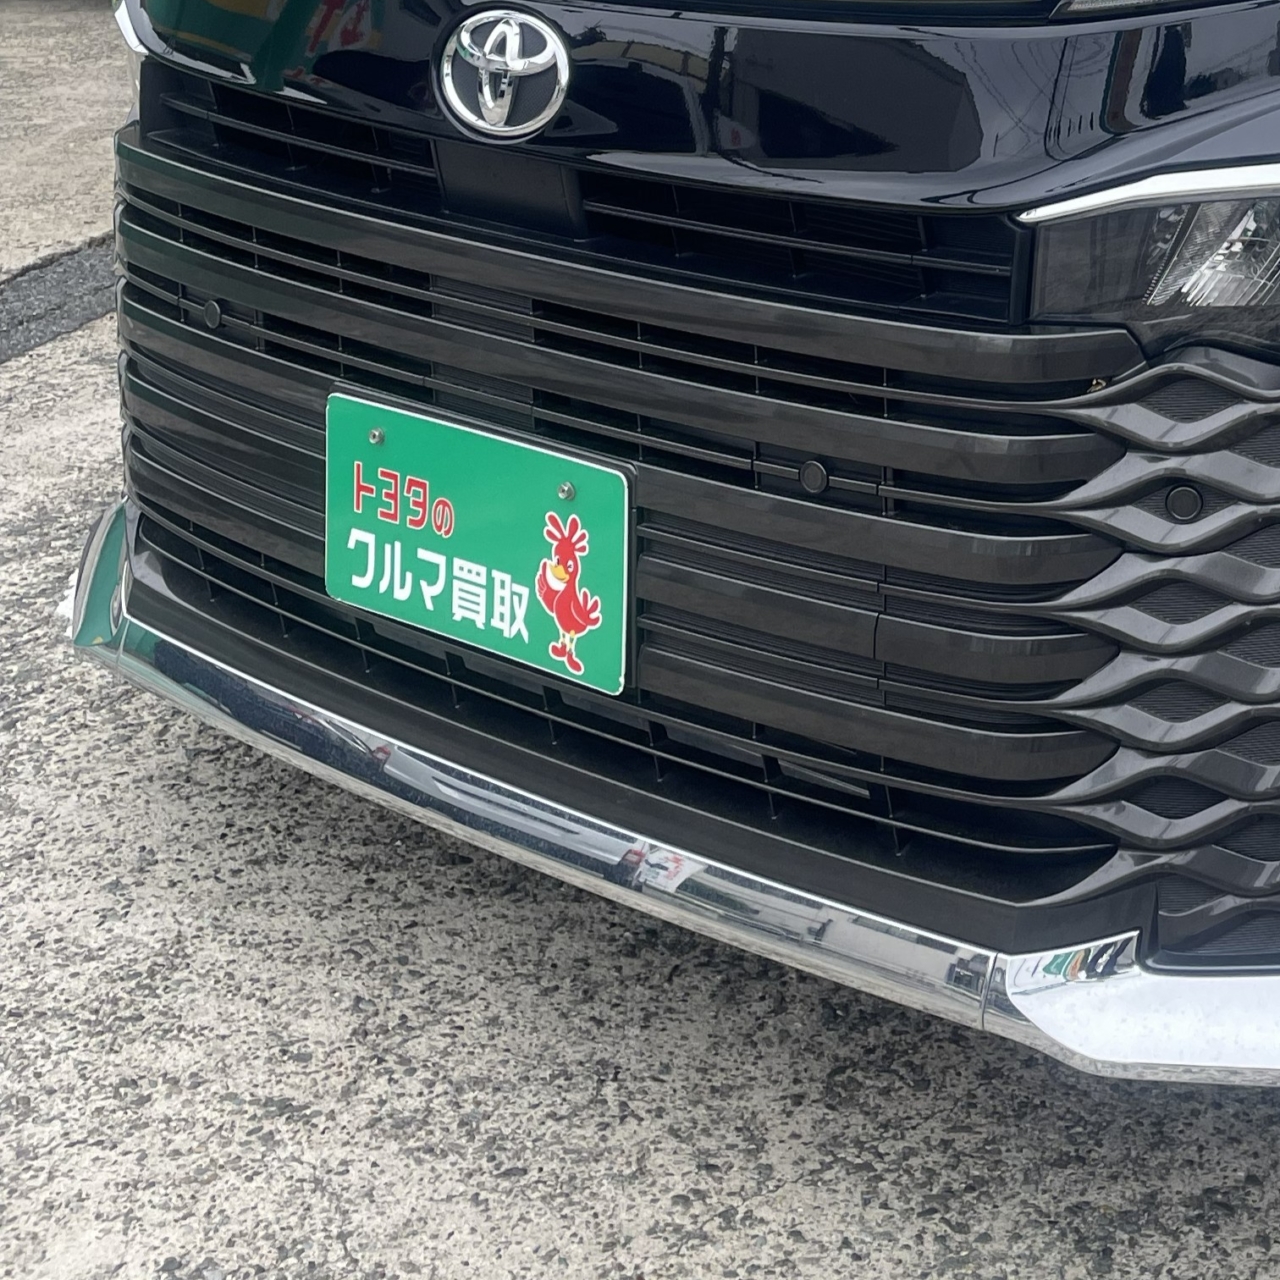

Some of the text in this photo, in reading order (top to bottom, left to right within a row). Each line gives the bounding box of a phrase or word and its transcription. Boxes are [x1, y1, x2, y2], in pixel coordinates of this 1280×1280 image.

[353, 460, 455, 539] トヨタの
[347, 527, 530, 645] クルマ買取
